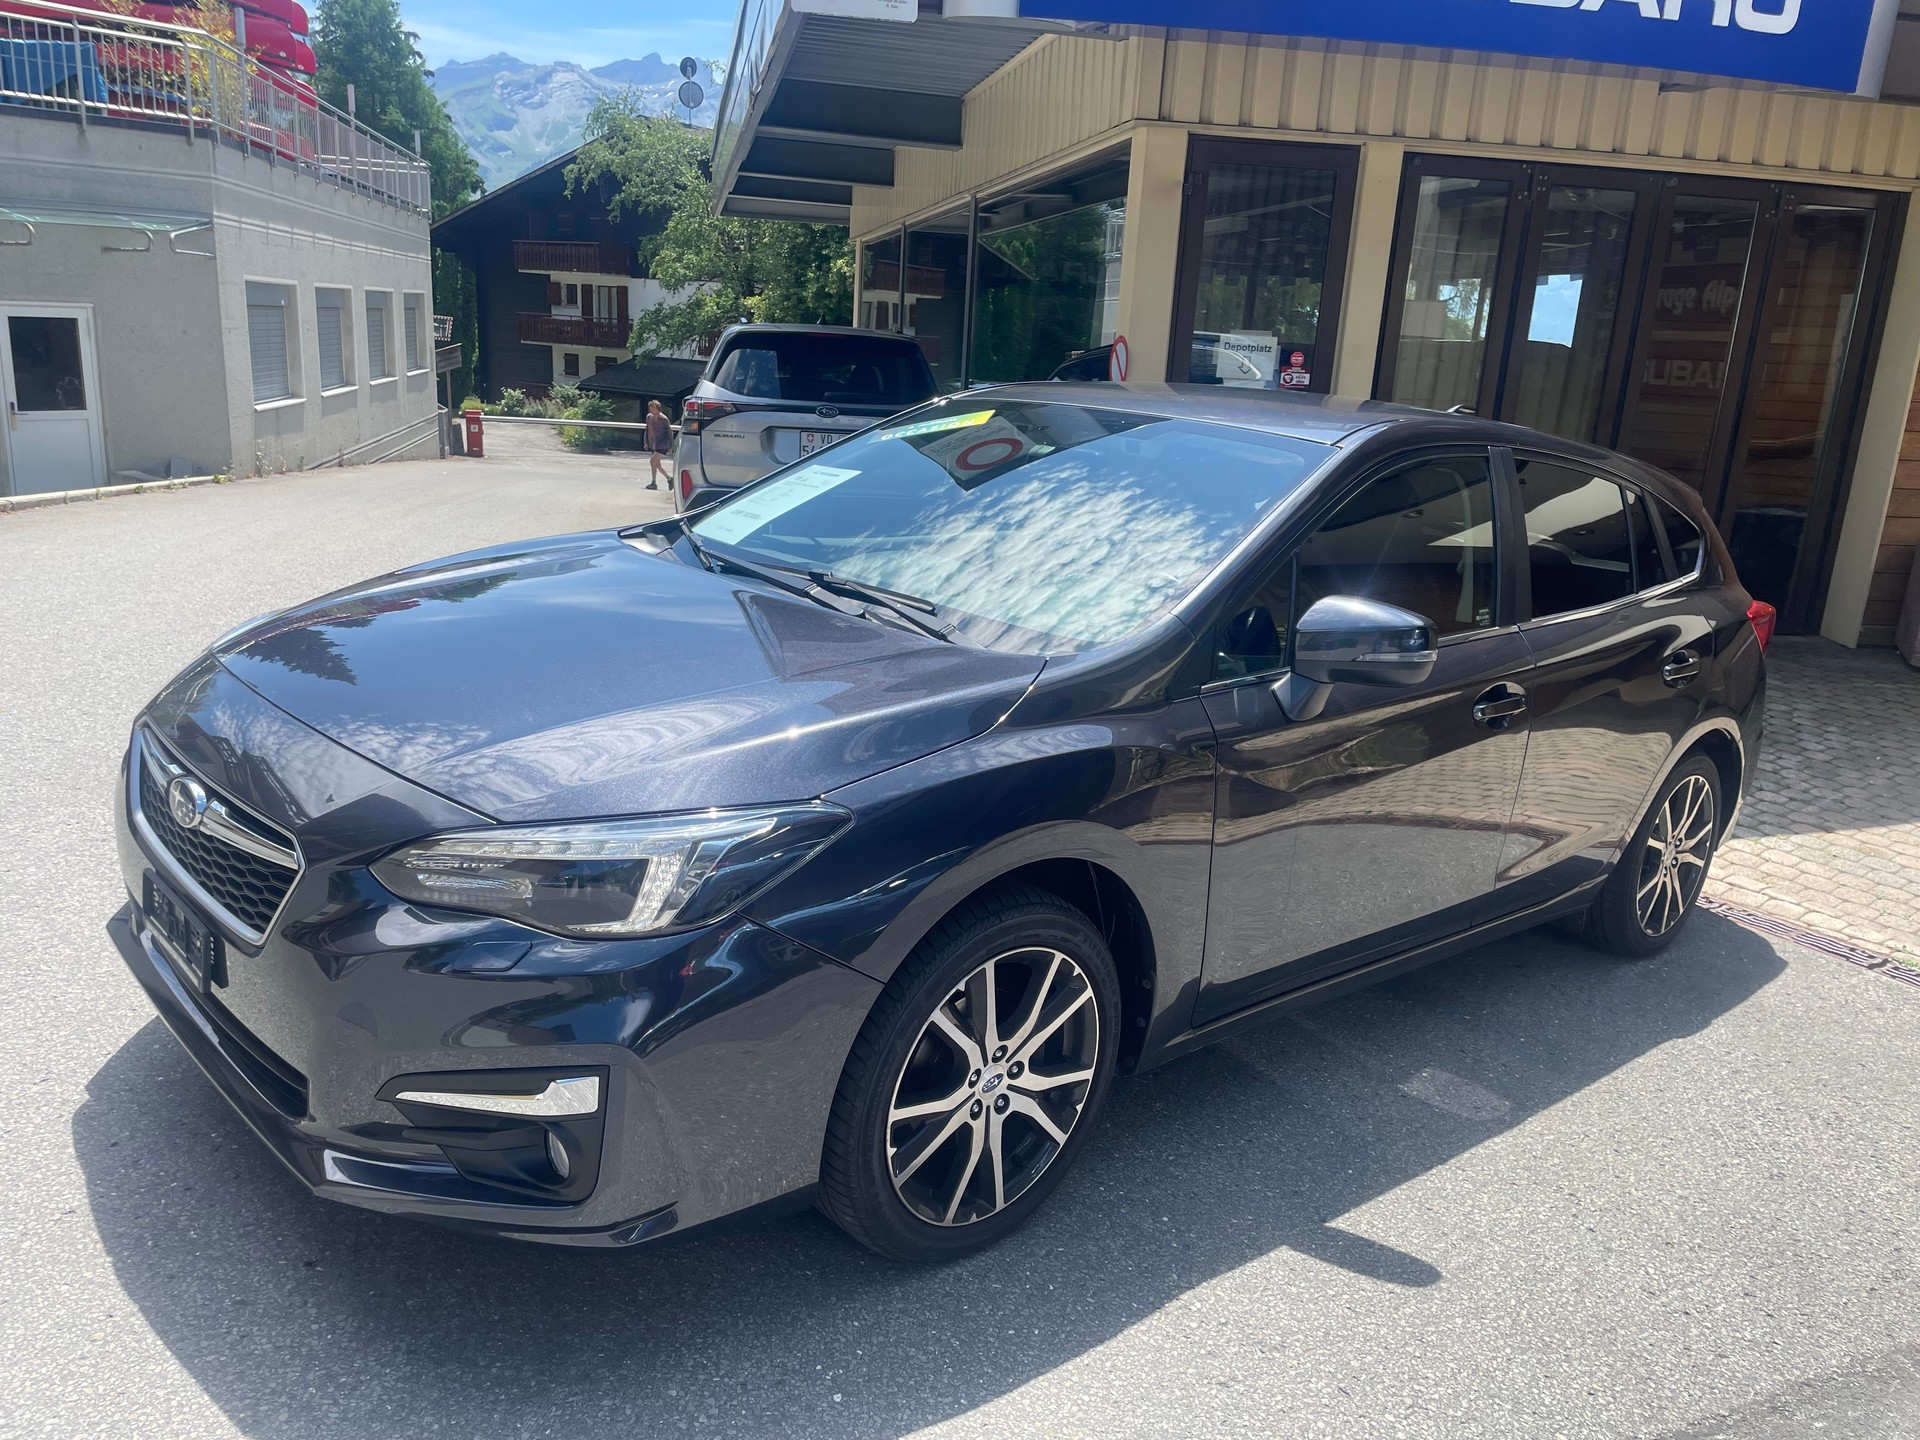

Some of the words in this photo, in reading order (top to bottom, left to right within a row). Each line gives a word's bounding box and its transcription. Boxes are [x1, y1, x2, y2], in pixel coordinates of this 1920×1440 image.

[1224, 342, 1273, 354] Depotplatz
[881, 419, 976, 441] OCCASION
[820, 434, 833, 444] VD
